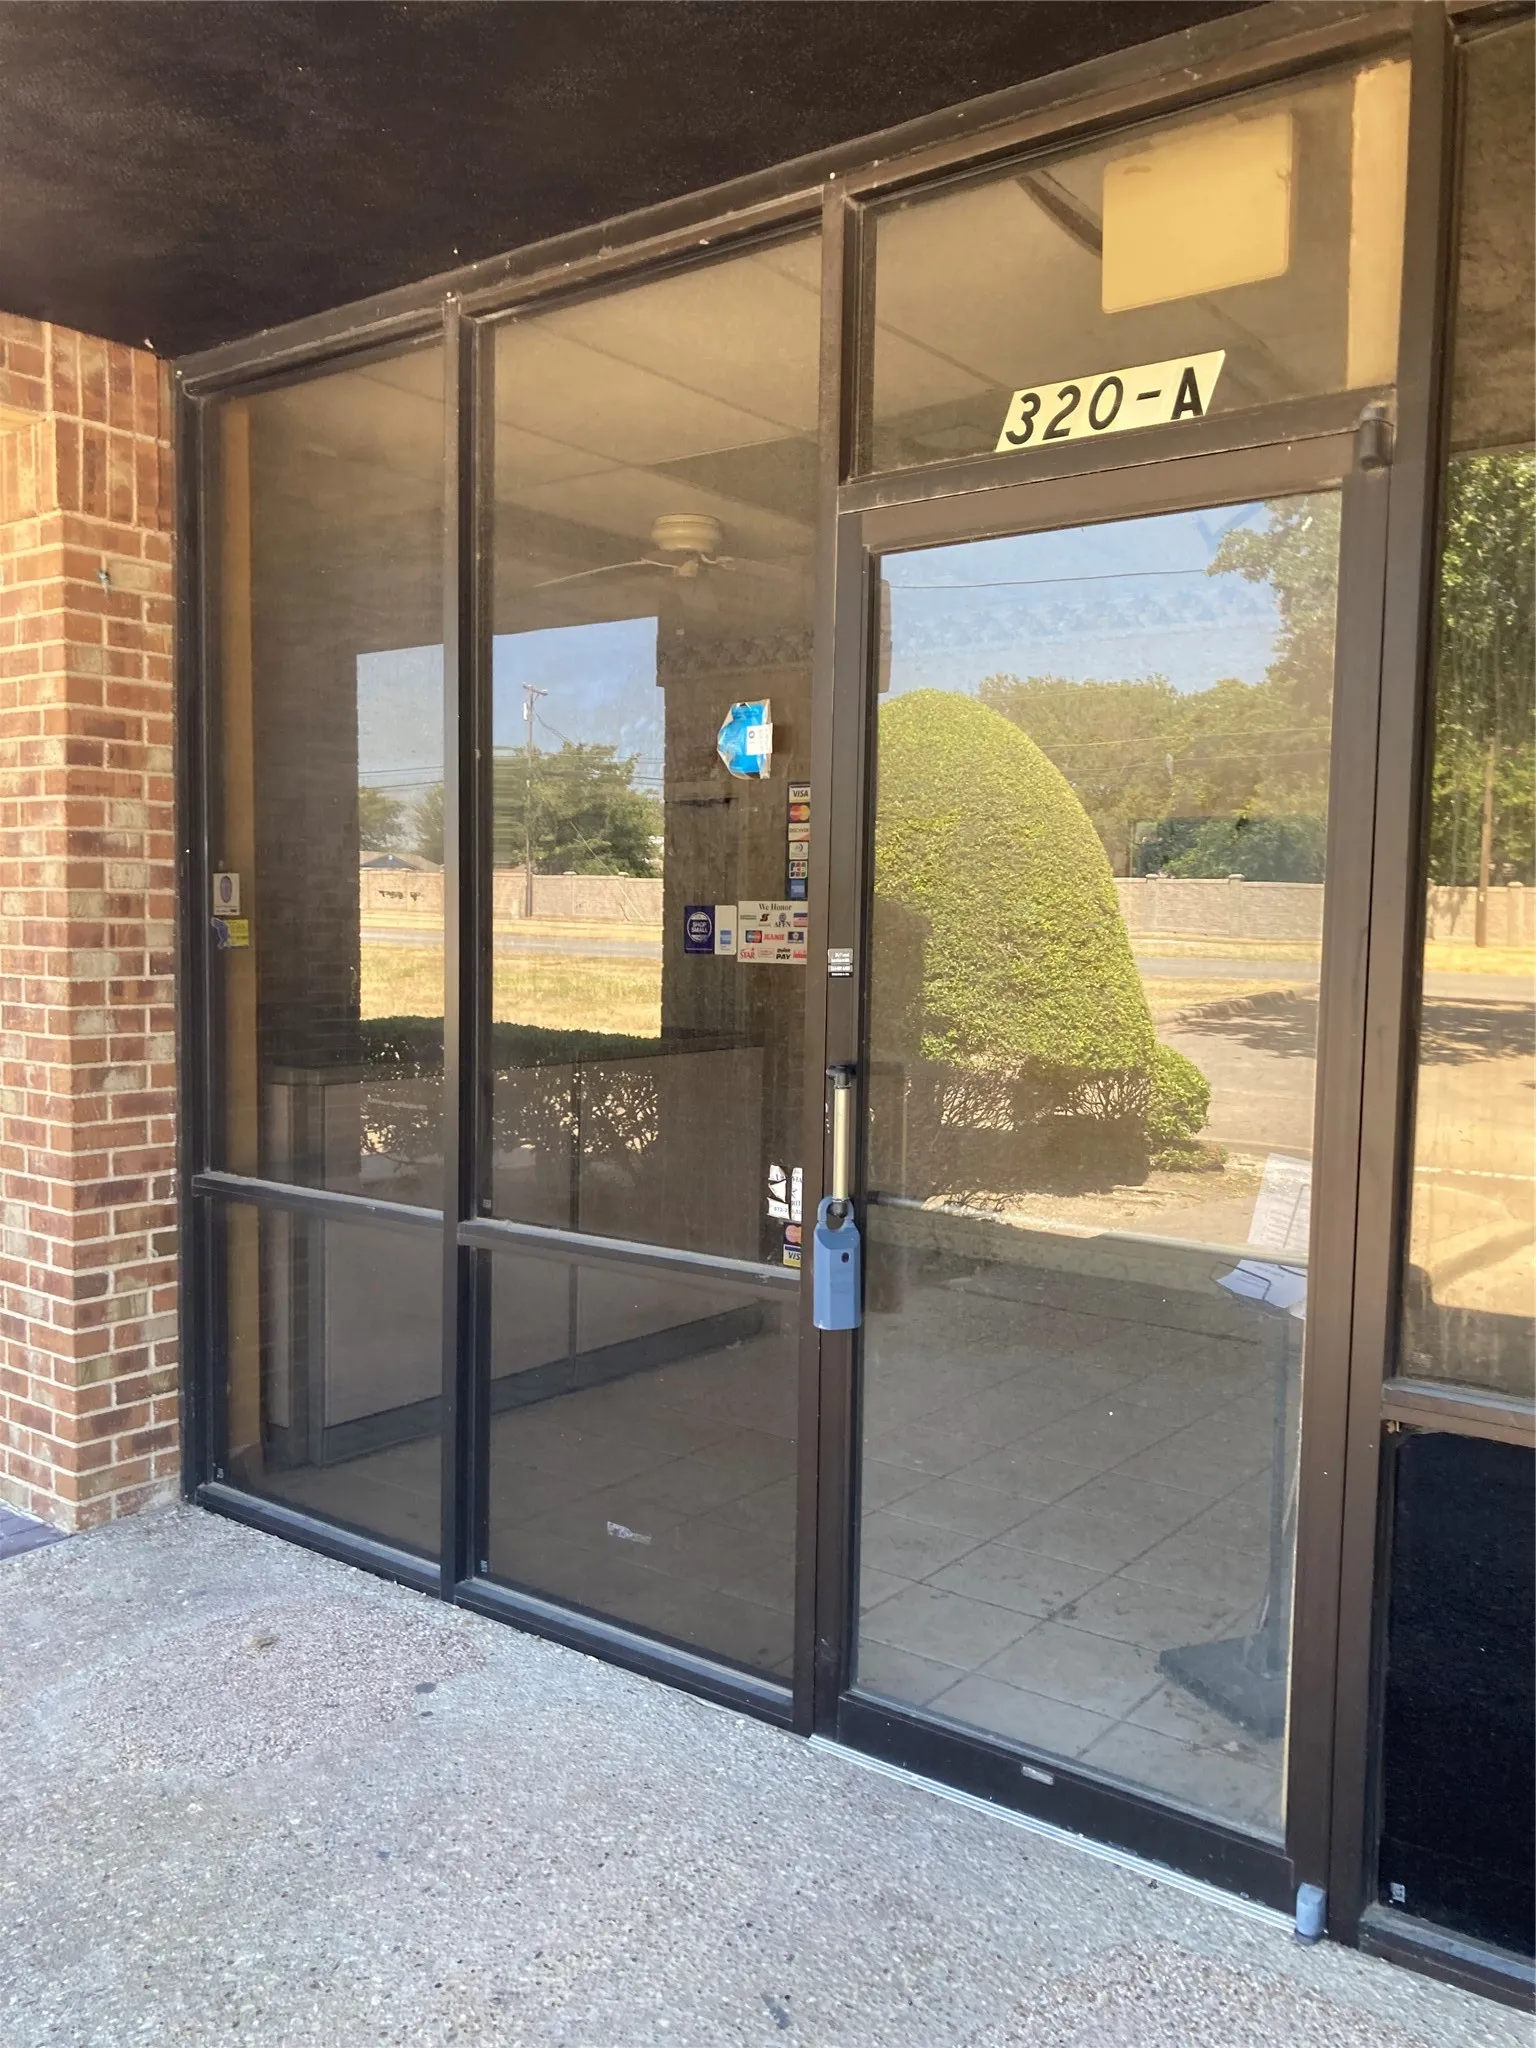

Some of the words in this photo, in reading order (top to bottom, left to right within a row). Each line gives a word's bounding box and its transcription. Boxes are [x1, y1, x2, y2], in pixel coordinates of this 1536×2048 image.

[1006, 367, 1204, 445] 320-A
[793, 790, 809, 798] VISA
[759, 903, 769, 911] We
[771, 903, 793, 911] Honor
[740, 951, 756, 960] STAR
[788, 1251, 801, 1261] VIS
